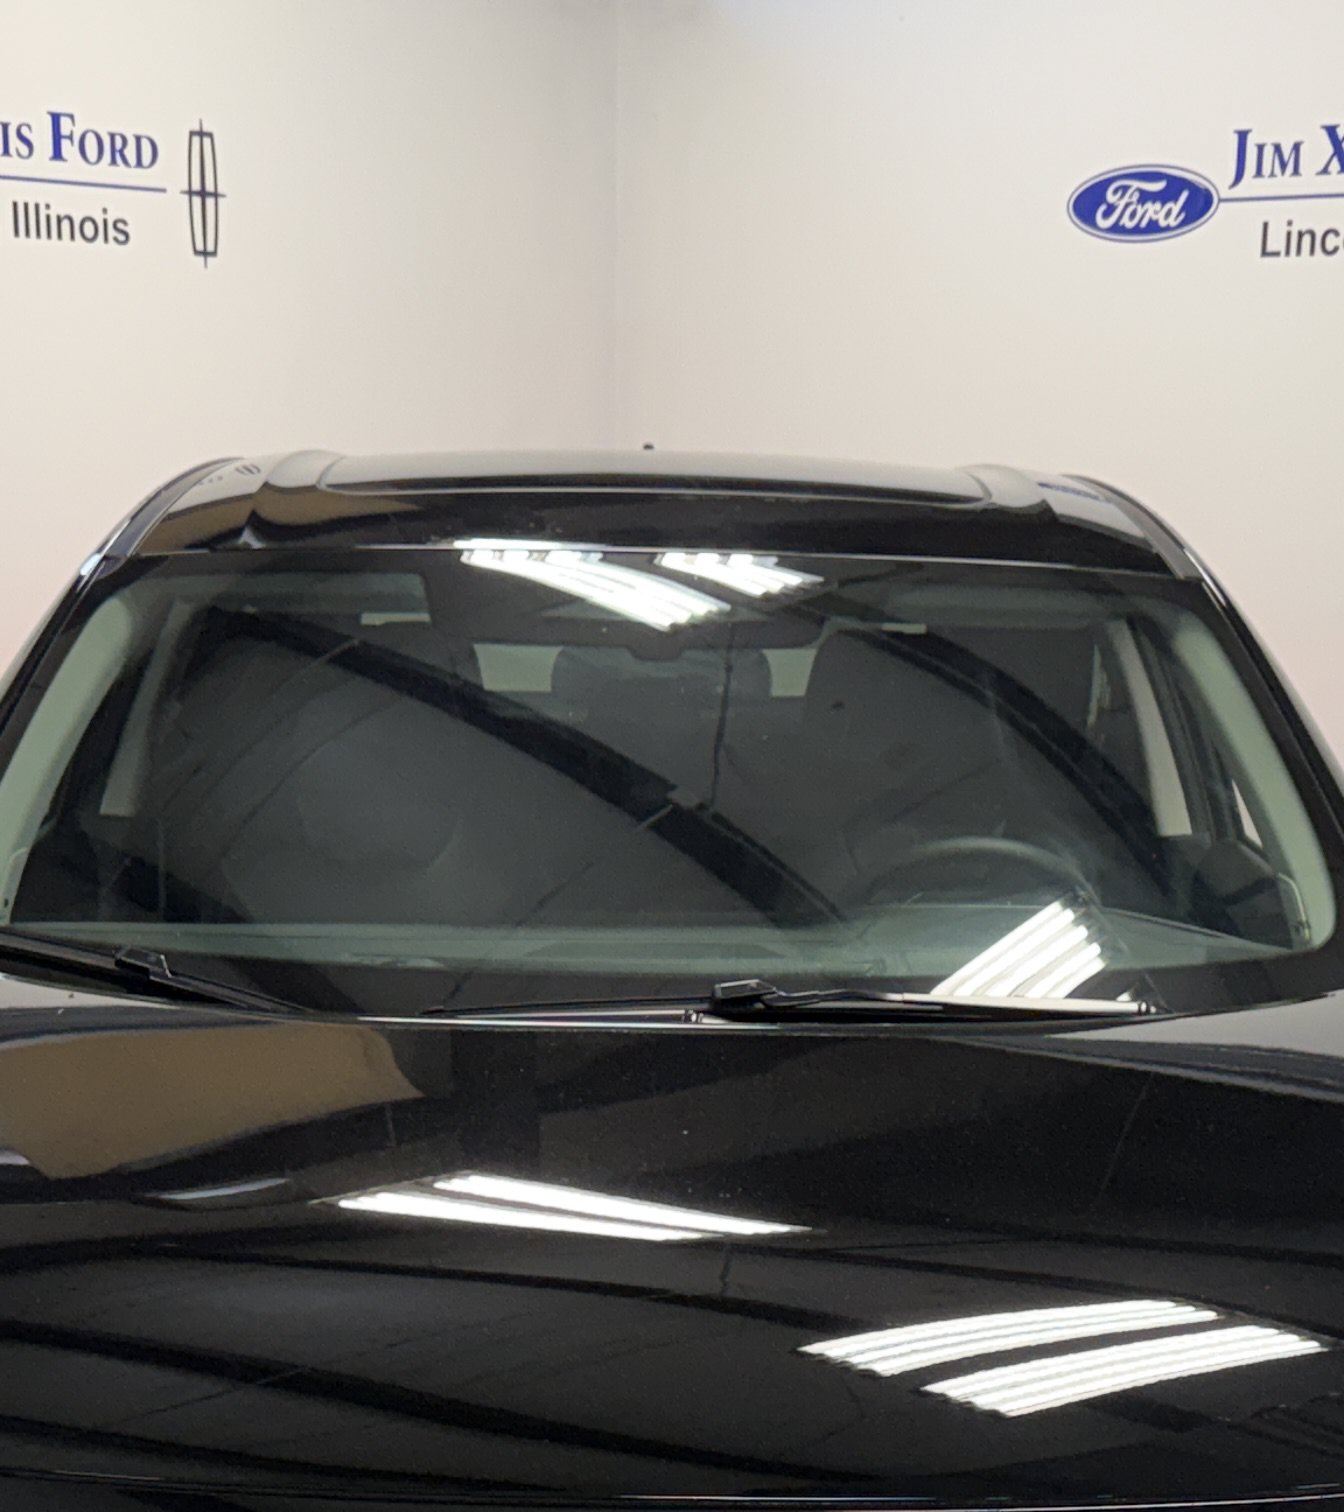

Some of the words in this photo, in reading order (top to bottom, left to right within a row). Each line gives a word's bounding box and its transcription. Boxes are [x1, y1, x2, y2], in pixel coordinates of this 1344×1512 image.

[47, 112, 159, 169] FORD
[1229, 129, 1303, 189] JIM
[13, 201, 130, 245] Illinois
[1096, 179, 1185, 230] Ford
